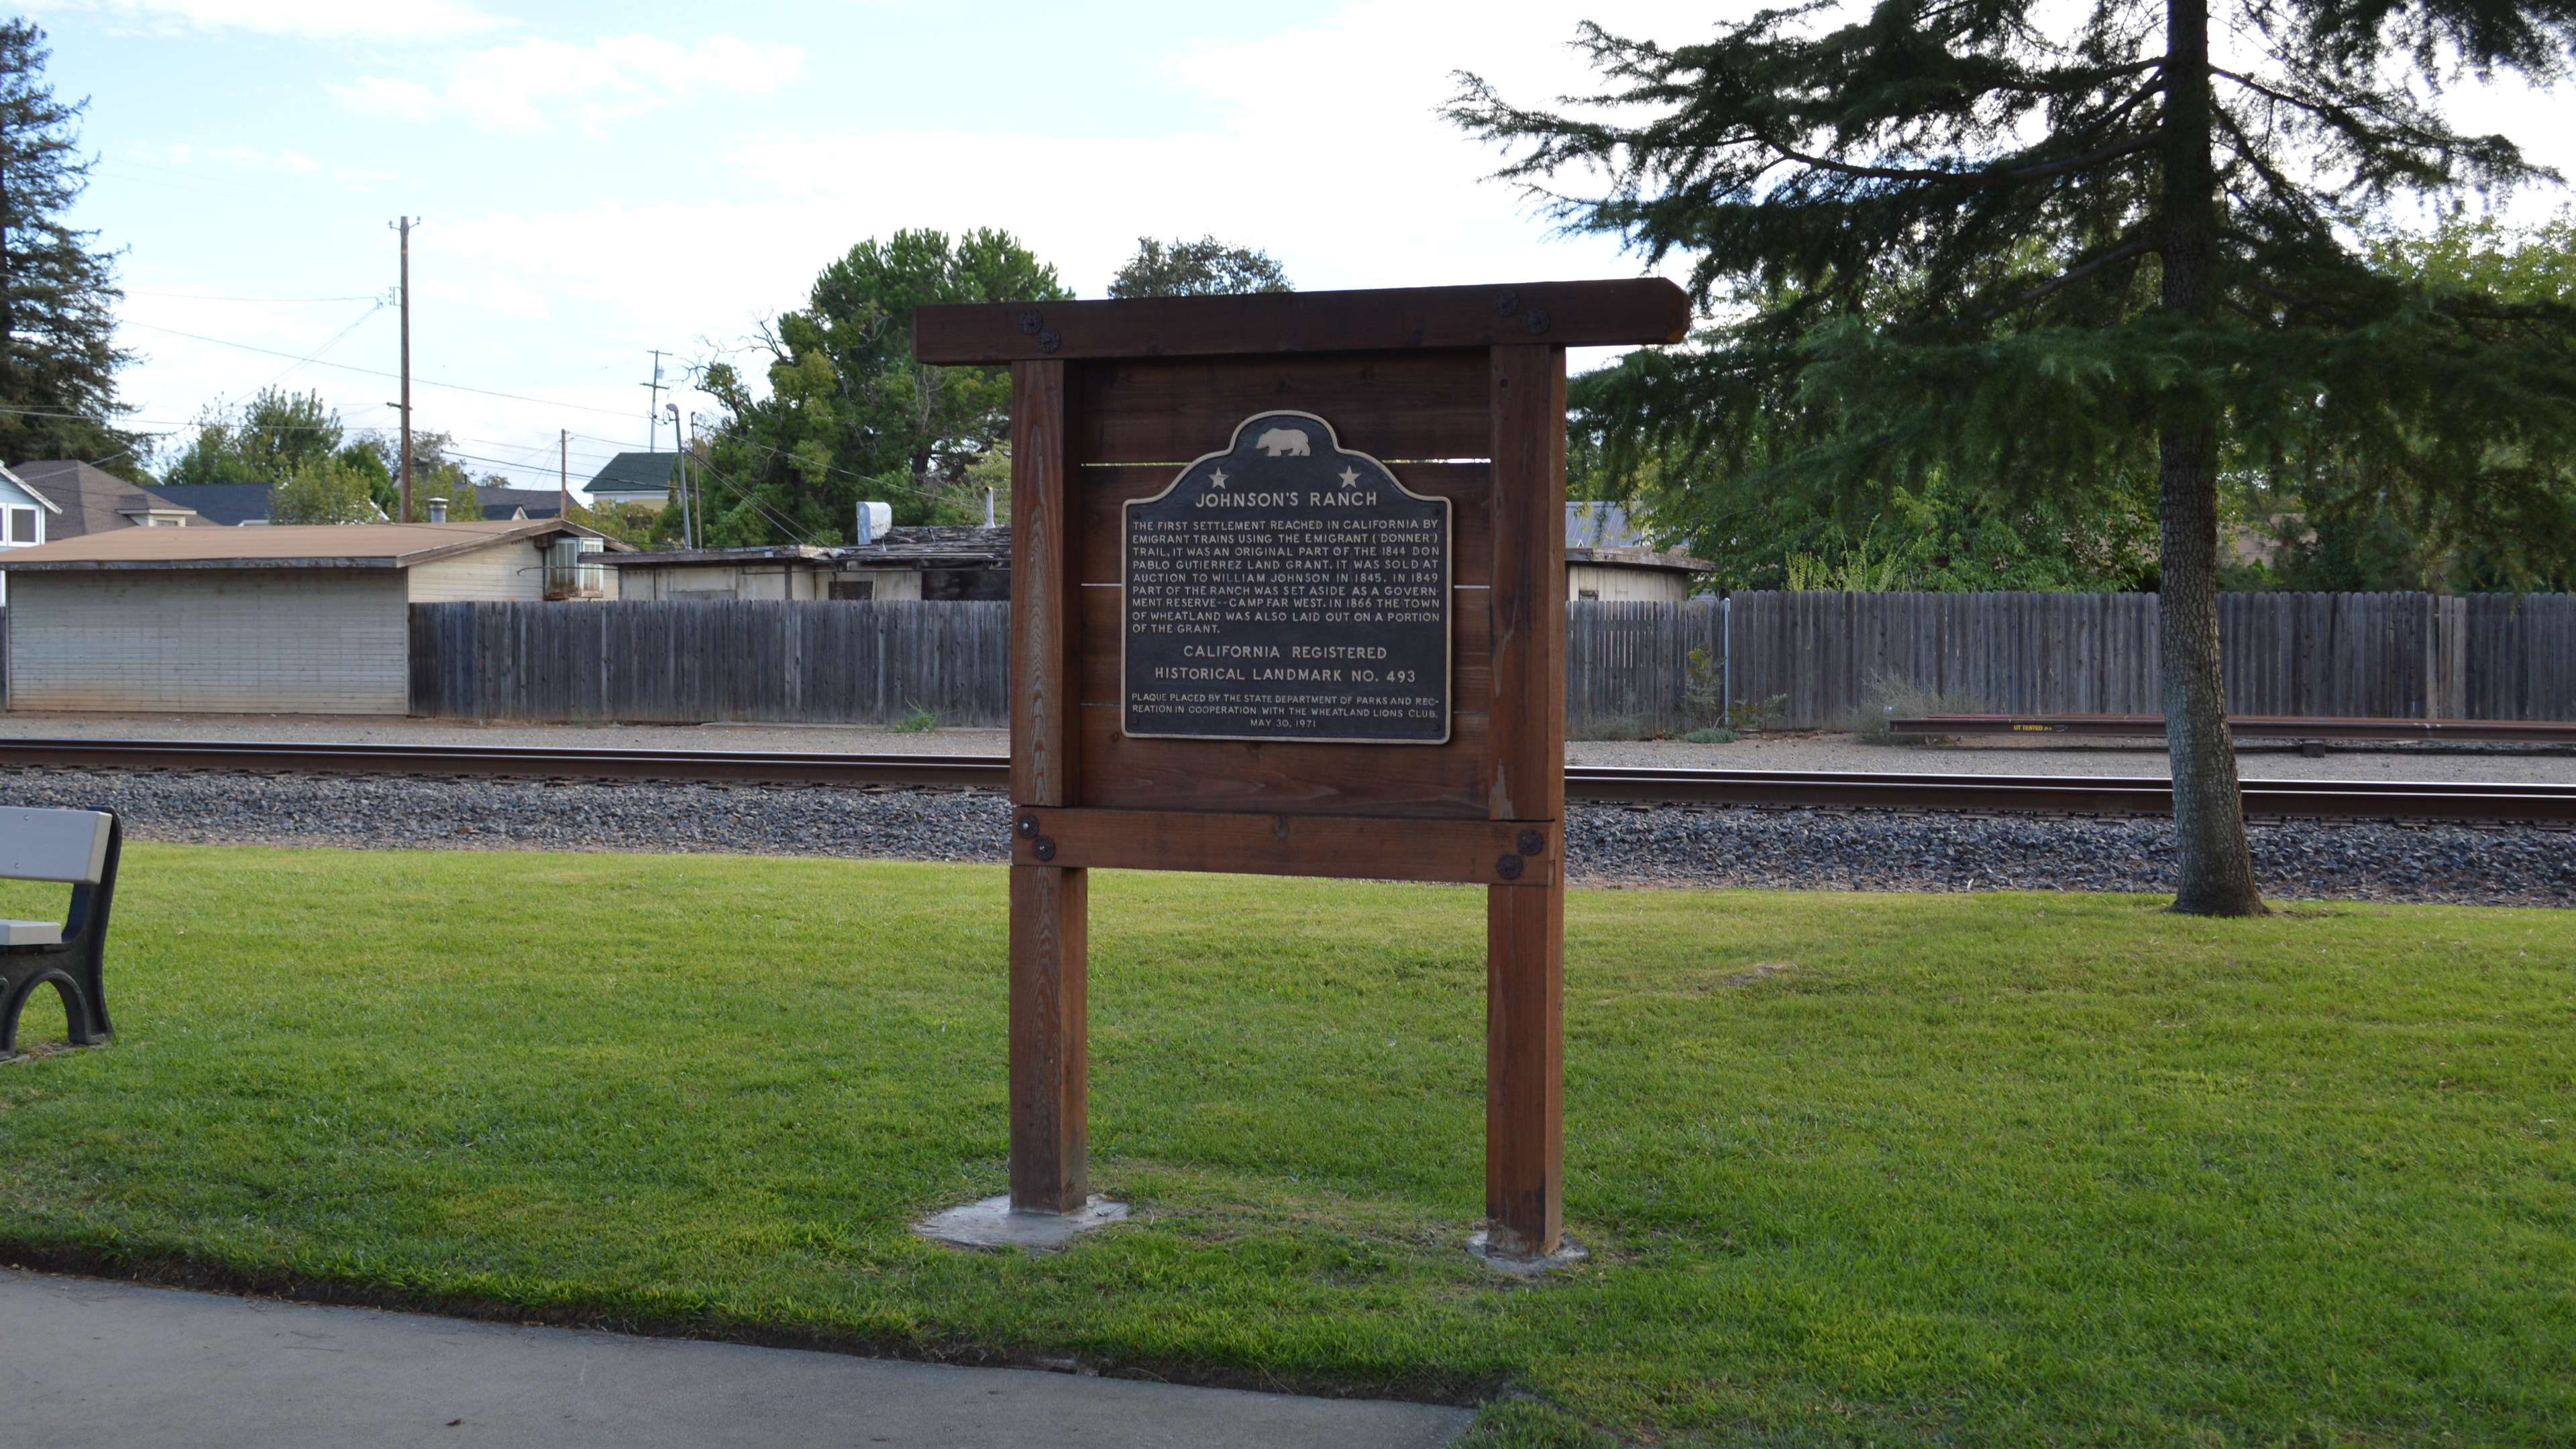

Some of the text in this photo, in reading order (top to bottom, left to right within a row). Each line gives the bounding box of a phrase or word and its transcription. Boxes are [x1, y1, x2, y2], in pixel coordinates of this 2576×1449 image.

[1195, 492, 1376, 507] JOHNSON'S RANCH
[1133, 519, 1438, 531] THE FIRST SETTLEMENT REACHED IN CALIFORNIA BY
[1133, 535, 1189, 543] EMIGRANT
[1193, 535, 1234, 543] TRAINS
[1238, 534, 1272, 543] USING
[1278, 534, 1299, 543] THE
[1305, 534, 1368, 543] EMIGRANT
[1173, 547, 1183, 556] IT
[1187, 547, 1210, 556] WAS
[1214, 547, 1229, 556] AN
[1235, 547, 1293, 556] ORIGINAL
[1299, 547, 1328, 556] PART
[1333, 547, 1350, 555] OF
[1354, 547, 1377, 555] THE
[1383, 547, 1405, 555] 1844
[1413, 547, 1439, 555] DON
[1133, 559, 1438, 570] PABLO GUTIERREZ LAND GRANT. IT WAS SOLD AT
[1134, 572, 1438, 583] AUCTION TO WILLIAM JOHNSON IN 1845. IN 1849
[1133, 586, 1161, 594] PART
[1167, 586, 1181, 595] OF
[1185, 586, 1206, 595] THE
[1210, 586, 1250, 595] RANCH
[1254, 586, 1278, 595] WAS
[1283, 586, 1305, 595] SET
[1309, 586, 1345, 596] ASIDE
[1352, 586, 1366, 596] AS
[1371, 587, 1379, 596] A
[1133, 598, 1162, 606] MENT
[1267, 598, 1288, 607] FAR
[1293, 598, 1326, 607] WEST.
[1330, 598, 1341, 607] IN
[1347, 598, 1371, 608] 1866
[1377, 598, 1399, 608] THE
[1404, 599, 1439, 608] TOWN
[1132, 611, 1439, 622] OF WHEATLAND WAS ALSO LAID OUT ON A PORTION
[1133, 624, 1220, 633] OF THE GRANT.
[1184, 645, 1387, 659] CALIFORNIA REGISTERED
[1156, 667, 1415, 683] HISTORICAL LANDMARK NO. 493
[1132, 693, 1167, 701] PLAQUE
[1170, 694, 1205, 702] PLACED
[1209, 694, 1220, 702] BY
[1224, 694, 1241, 702] THE
[1244, 694, 1272, 702] STATE
[1275, 695, 1337, 704] DEPARTMENT
[1340, 696, 1352, 704] OF
[1357, 696, 1387, 704] PARKS
[1416, 698, 1438, 706] REC-
[1132, 704, 1172, 713] REATION
[1189, 706, 1256, 714] COOPERATION
[1289, 707, 1306, 715] THE
[1311, 708, 1369, 716] WHEATLAND
[1374, 709, 1403, 717] LIONS
[1296, 719, 1315, 727] 1971
